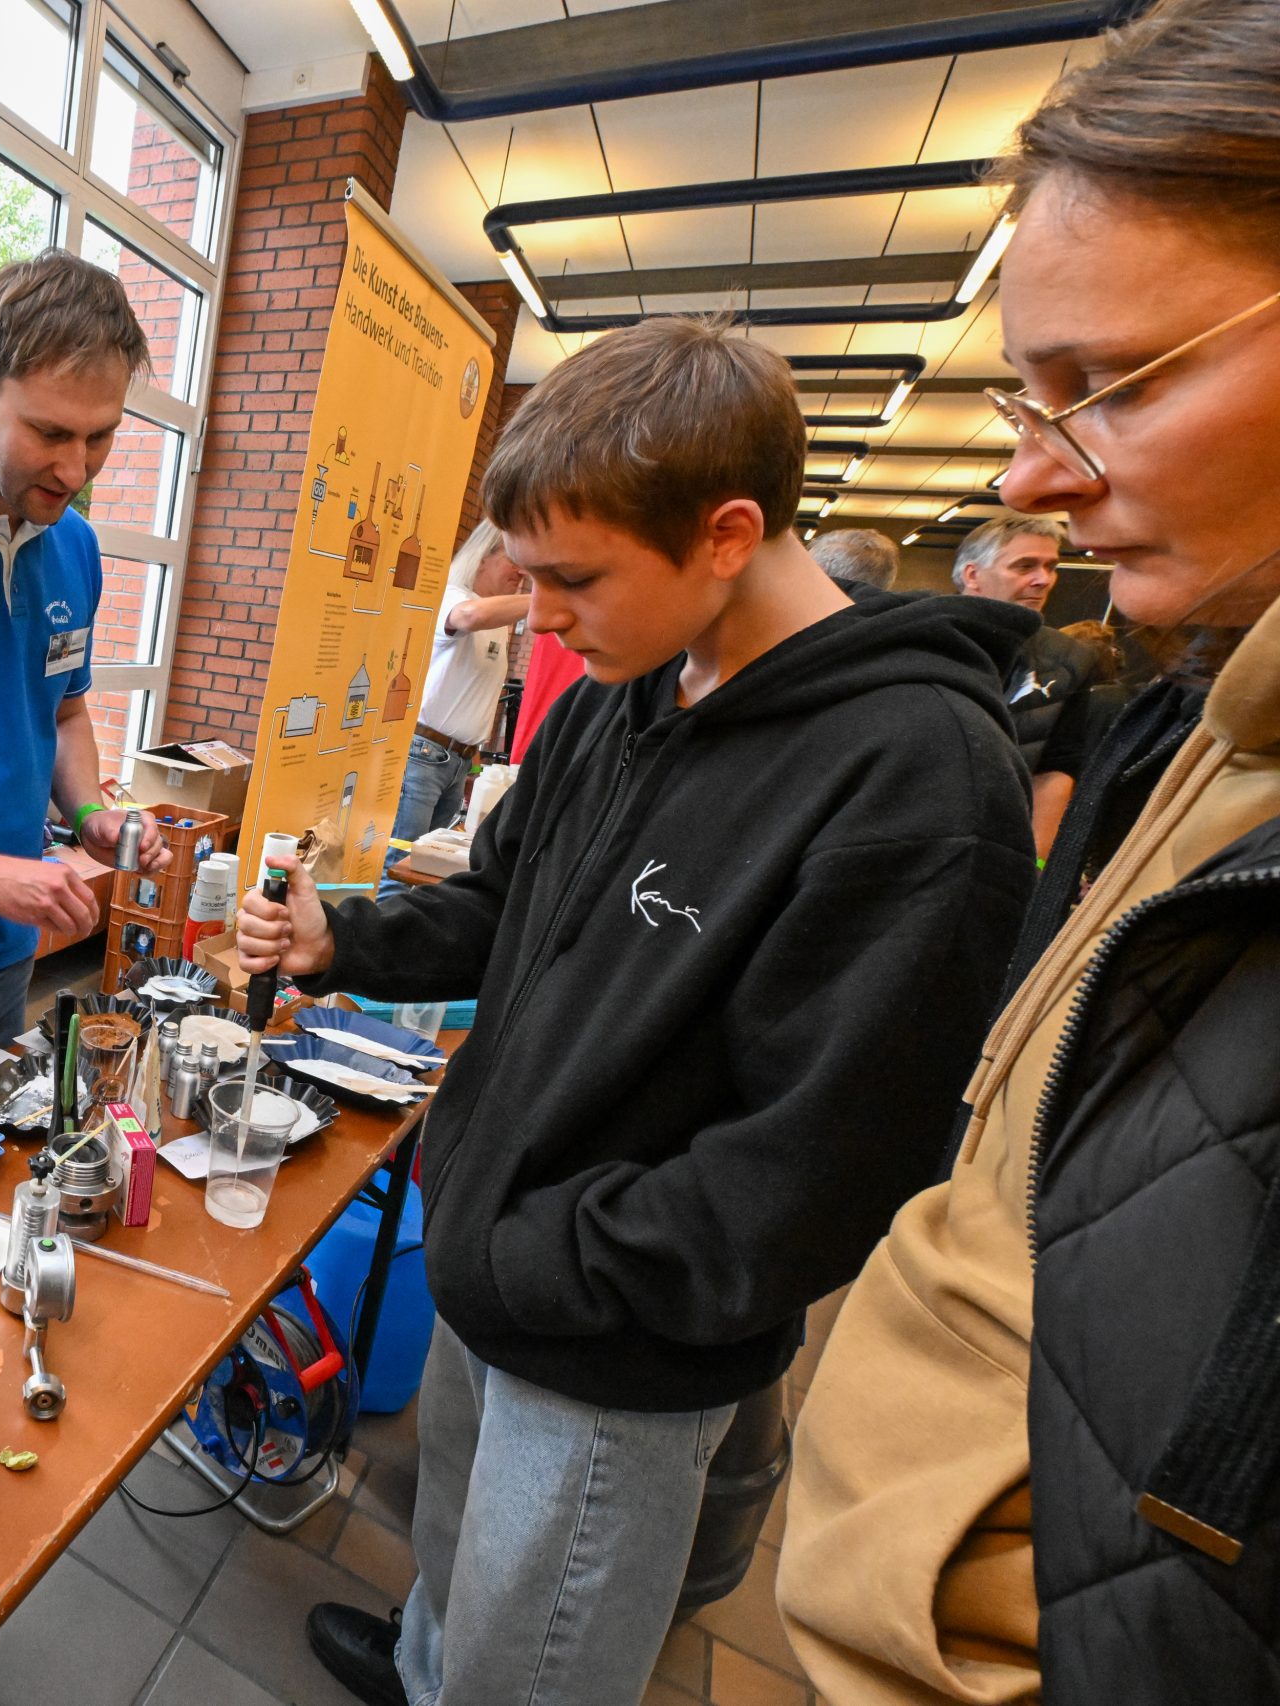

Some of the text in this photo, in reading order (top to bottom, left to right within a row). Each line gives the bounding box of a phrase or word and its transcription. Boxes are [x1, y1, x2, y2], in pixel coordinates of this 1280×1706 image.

[343, 290, 444, 392] Handwerk und Tradition
[352, 244, 368, 283] Die
[368, 262, 398, 310] Kunst
[398, 289, 413, 323] des
[413, 304, 444, 350] Brauens
